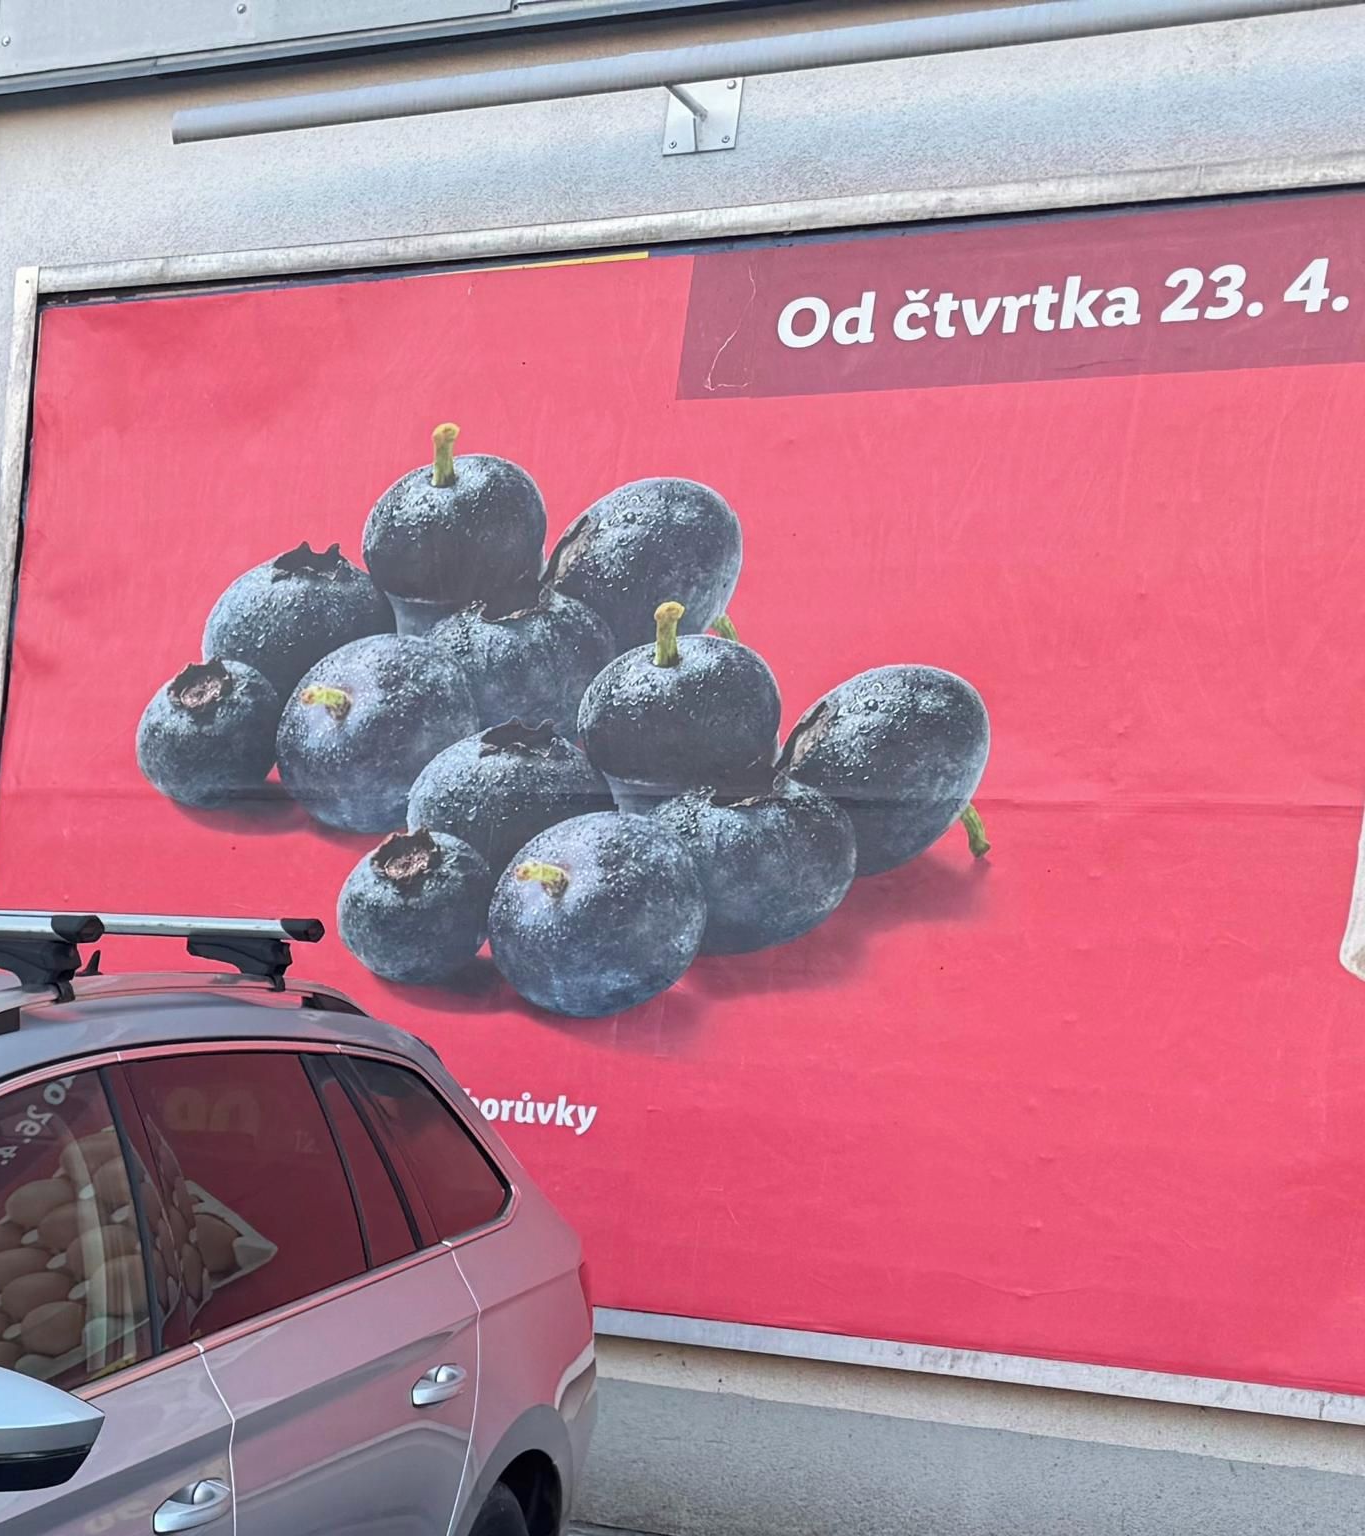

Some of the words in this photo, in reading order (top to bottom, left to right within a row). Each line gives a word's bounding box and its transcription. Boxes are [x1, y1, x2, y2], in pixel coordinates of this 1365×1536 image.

[777, 291, 876, 349] Od
[892, 275, 1142, 342] čtvrtka
[1160, 264, 1264, 323] 23.
[1283, 257, 1350, 313] 4.
